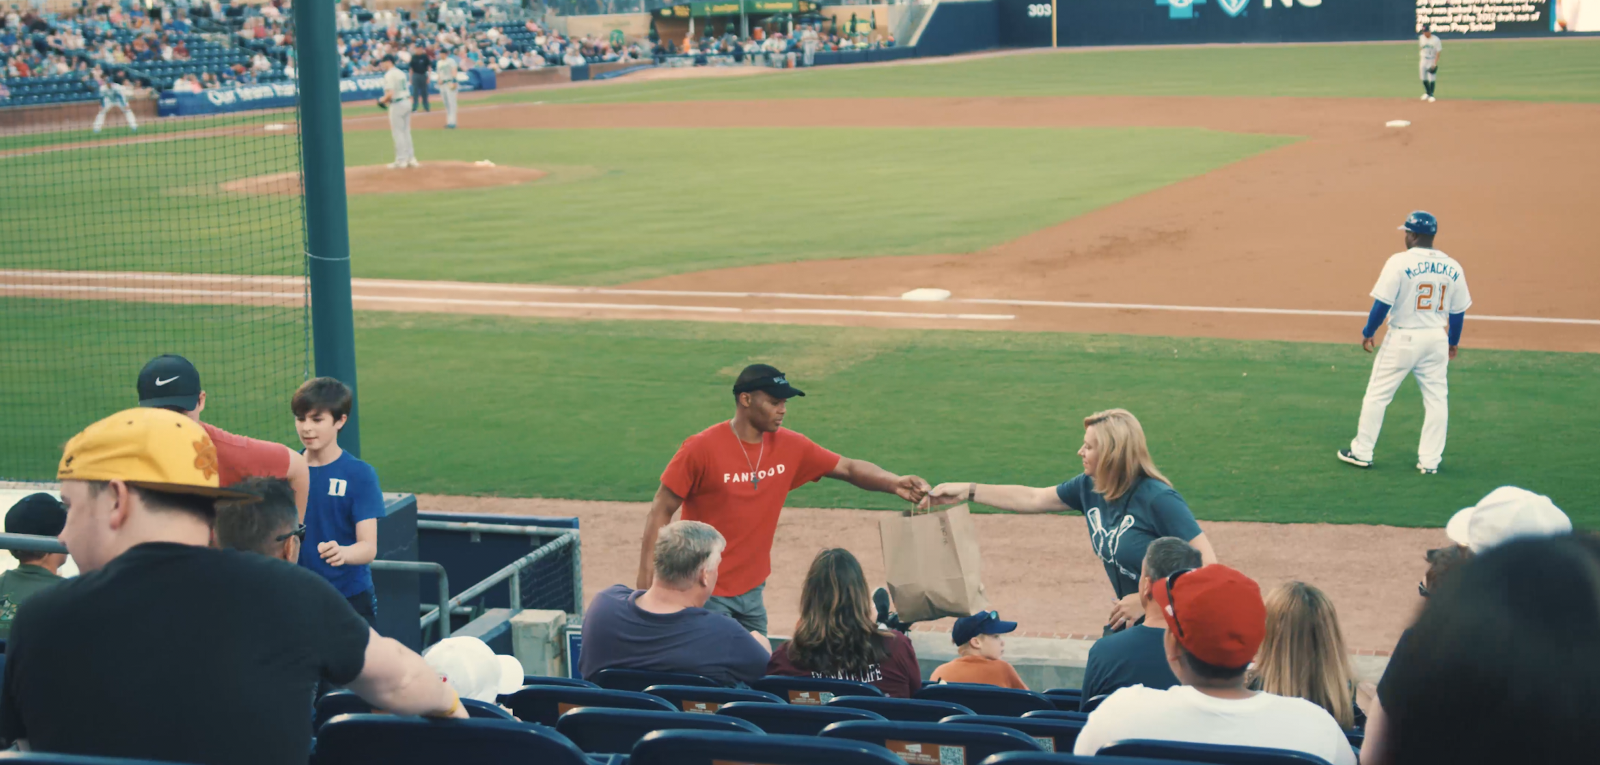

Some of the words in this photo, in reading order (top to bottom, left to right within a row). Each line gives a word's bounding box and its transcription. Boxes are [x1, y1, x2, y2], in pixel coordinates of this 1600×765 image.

[1028, 3, 1052, 17] 303
[1405, 261, 1460, 282] McCRACKEN
[1416, 283, 1448, 311] 21
[723, 463, 786, 483] FANFOOD
